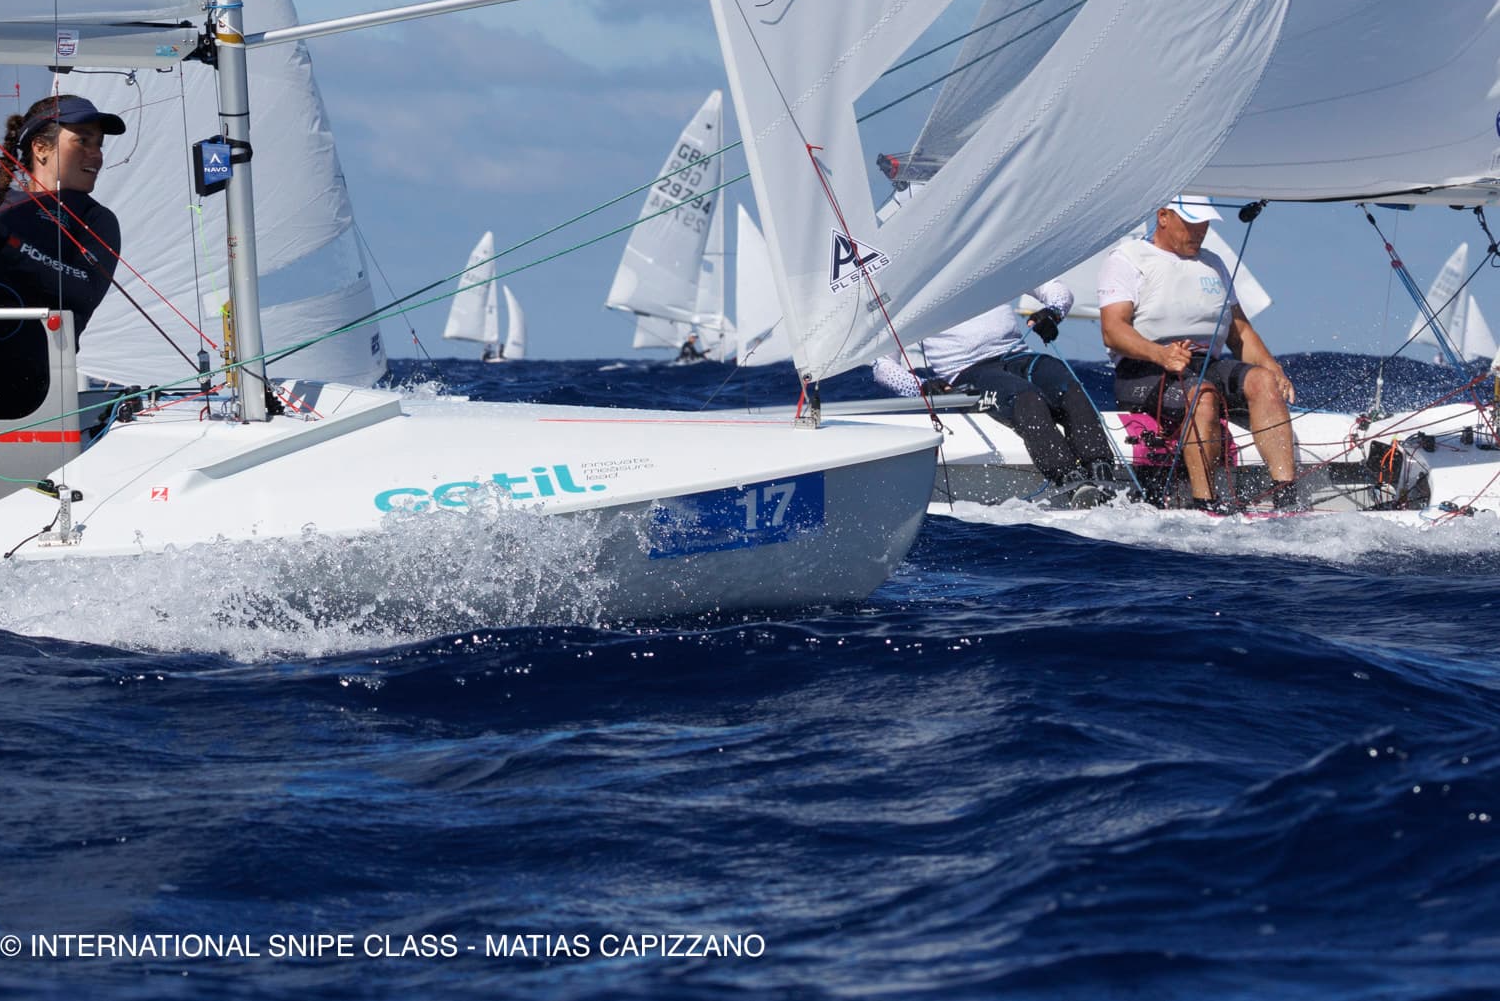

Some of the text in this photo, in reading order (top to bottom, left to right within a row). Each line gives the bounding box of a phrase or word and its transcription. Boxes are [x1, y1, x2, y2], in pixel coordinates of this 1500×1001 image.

[677, 143, 711, 172] GBR
[831, 256, 890, 293] PL SAILS
[736, 482, 796, 530] 17
